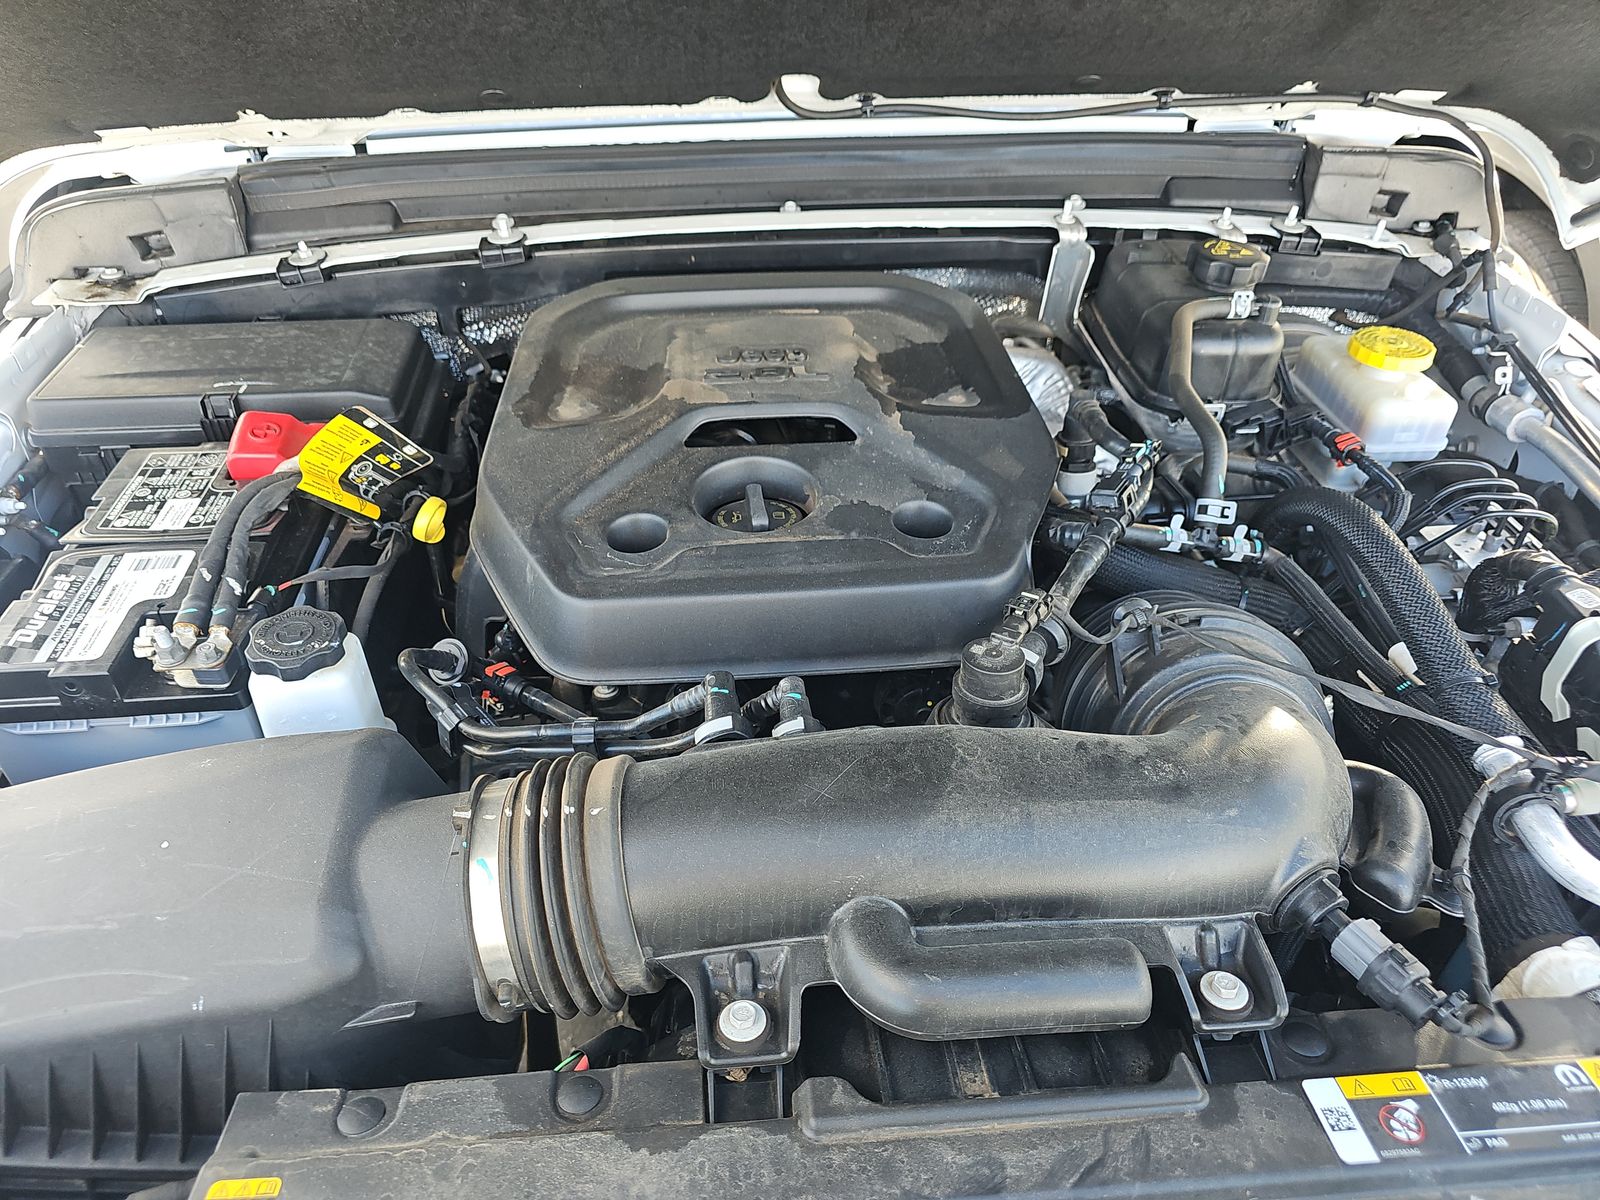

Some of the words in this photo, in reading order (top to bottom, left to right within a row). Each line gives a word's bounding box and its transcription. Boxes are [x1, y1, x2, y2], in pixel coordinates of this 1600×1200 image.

[7, 573, 76, 646] Duralast
[52, 575, 85, 617] PLATINUM
[62, 576, 96, 623] TECHNOLOGY
